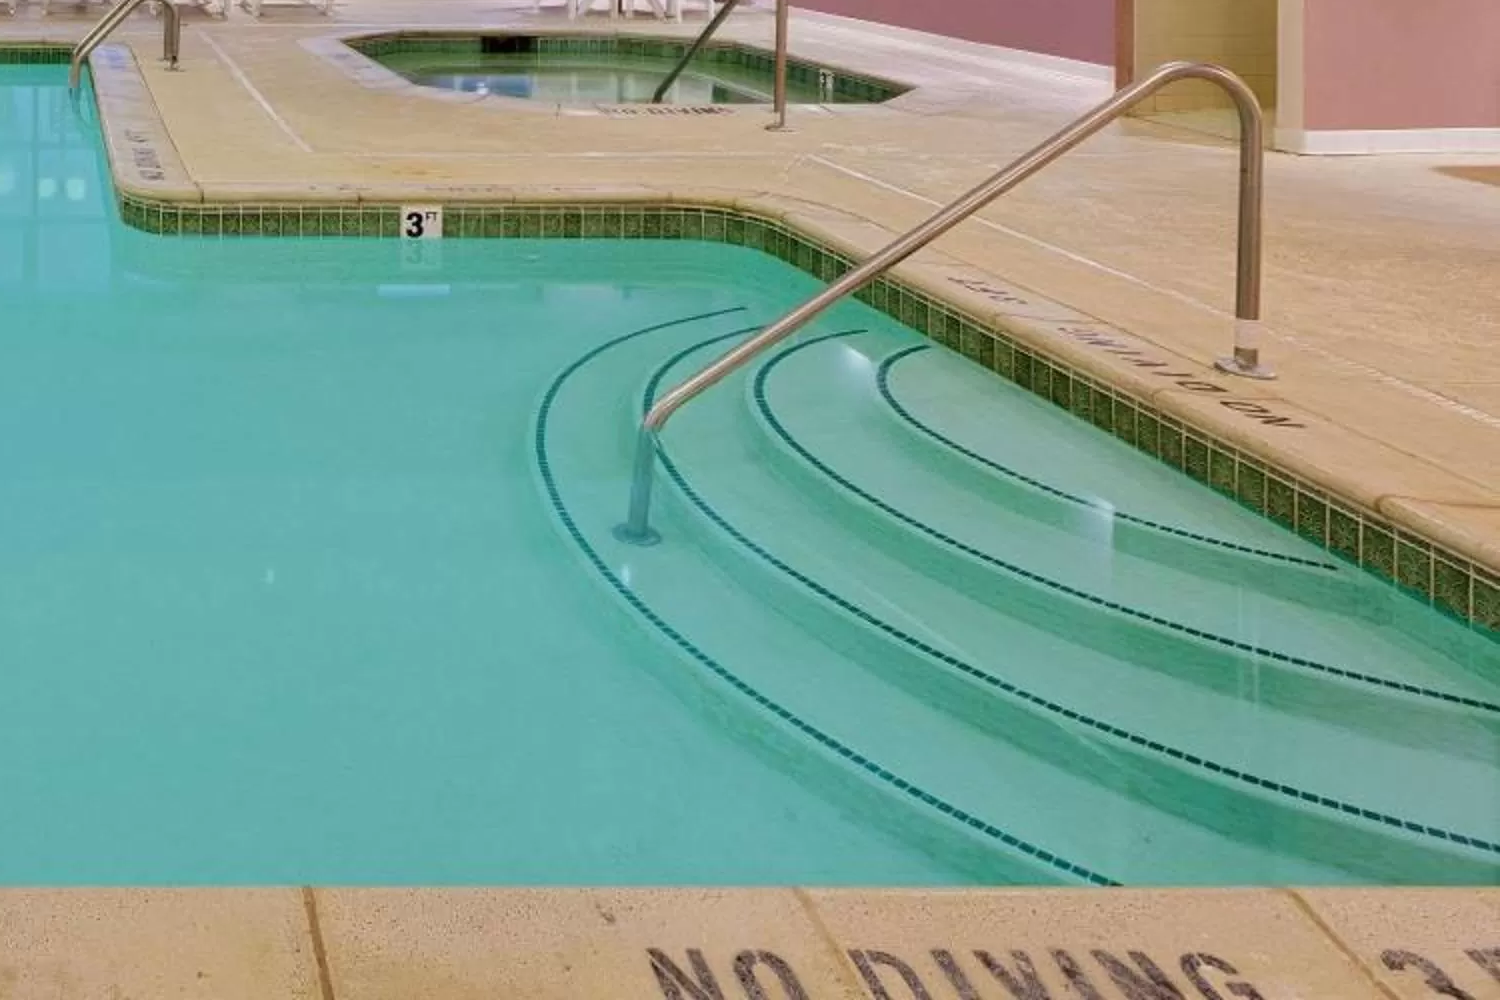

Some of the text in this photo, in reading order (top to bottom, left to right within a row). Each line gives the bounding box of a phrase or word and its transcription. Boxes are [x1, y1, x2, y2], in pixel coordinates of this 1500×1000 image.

[1218, 400, 1308, 429] NO
[645, 947, 811, 1000] NO
[845, 948, 1265, 1000] DIVING
